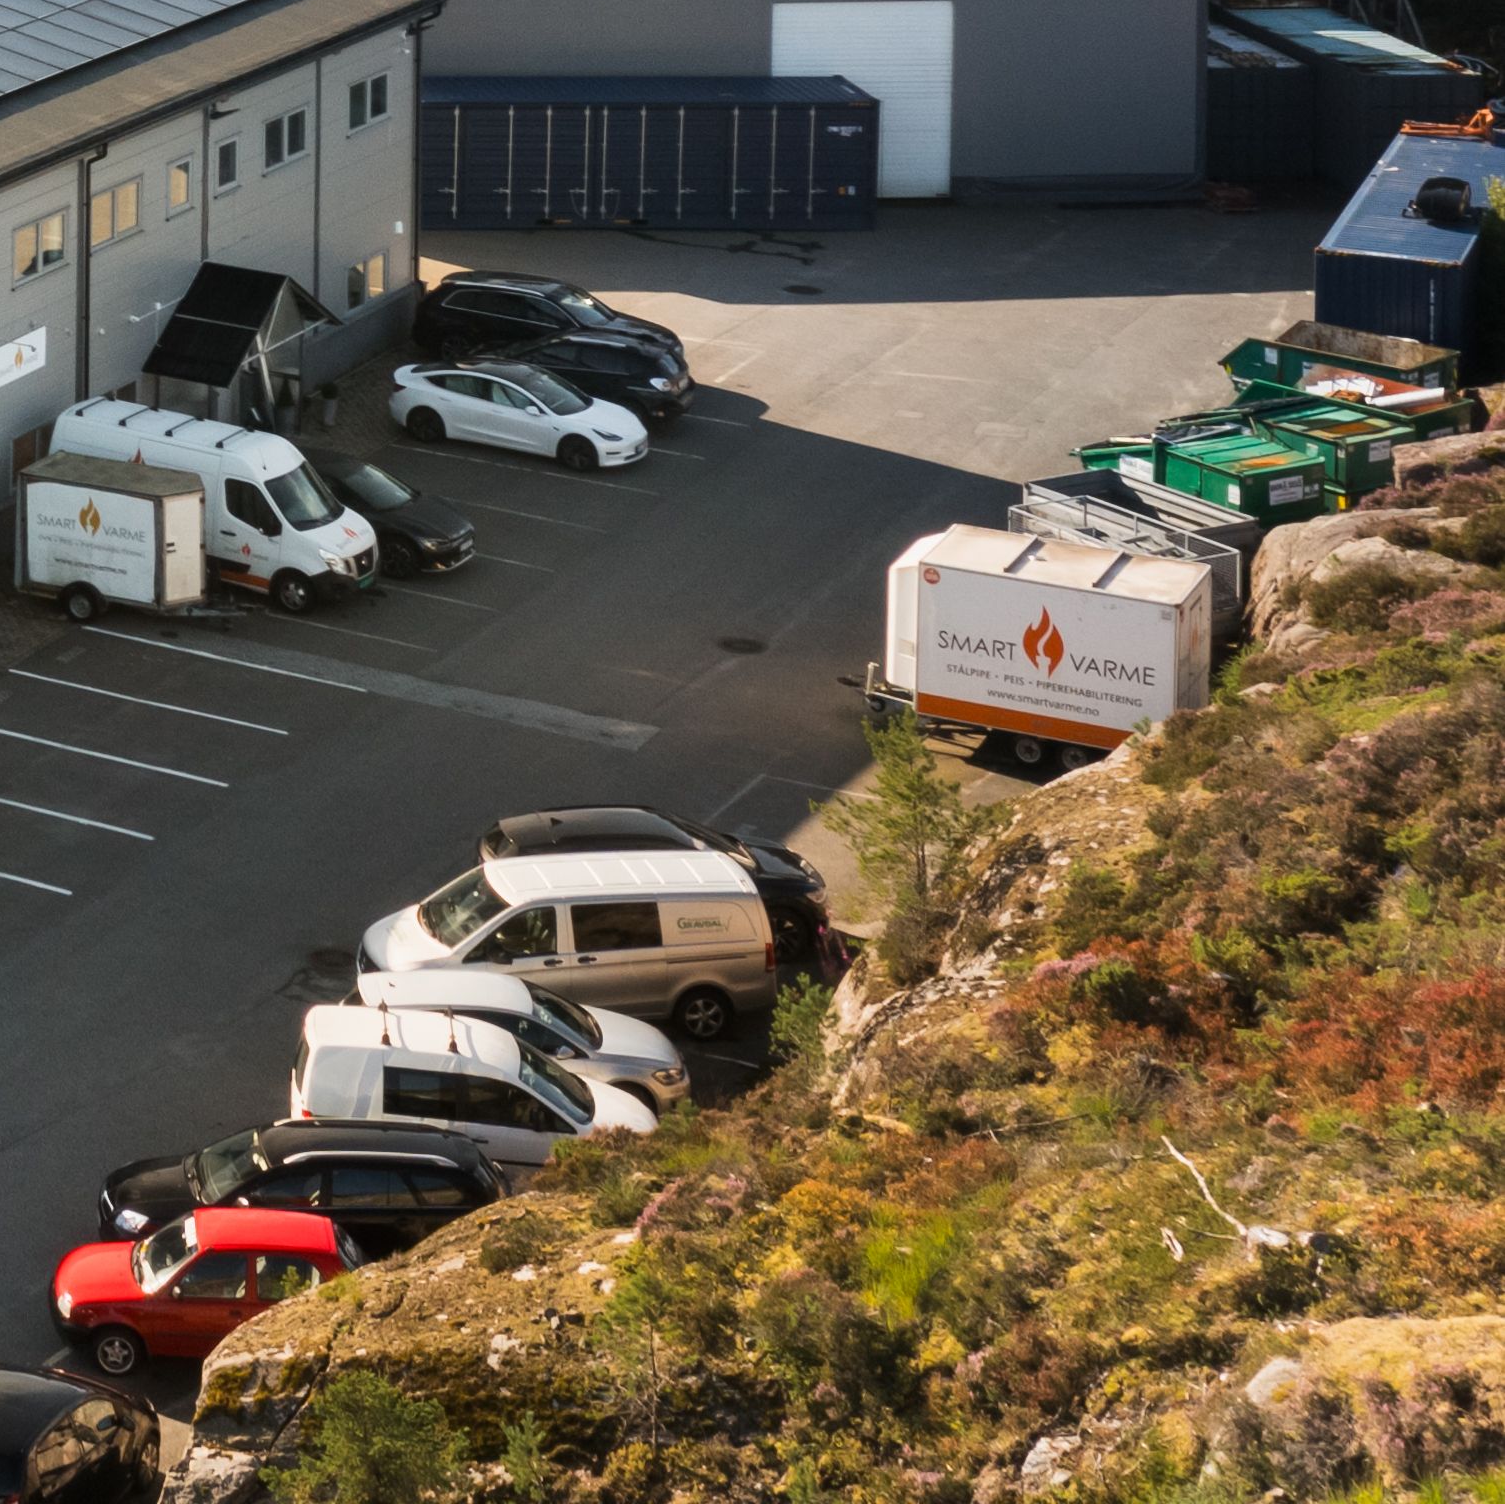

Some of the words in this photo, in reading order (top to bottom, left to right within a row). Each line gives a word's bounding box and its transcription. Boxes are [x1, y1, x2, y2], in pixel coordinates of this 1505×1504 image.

[36, 513, 77, 531] SMART
[102, 524, 147, 544] VARME
[937, 630, 1017, 661] SMART
[1069, 652, 1157, 686] VARME
[946, 662, 990, 679] STÅLPIPE
[1003, 673, 1025, 687] PEIS
[1036, 679, 1144, 708] PIPEREHABILITERING
[987, 688, 1100, 717] www.smartvarme.no
